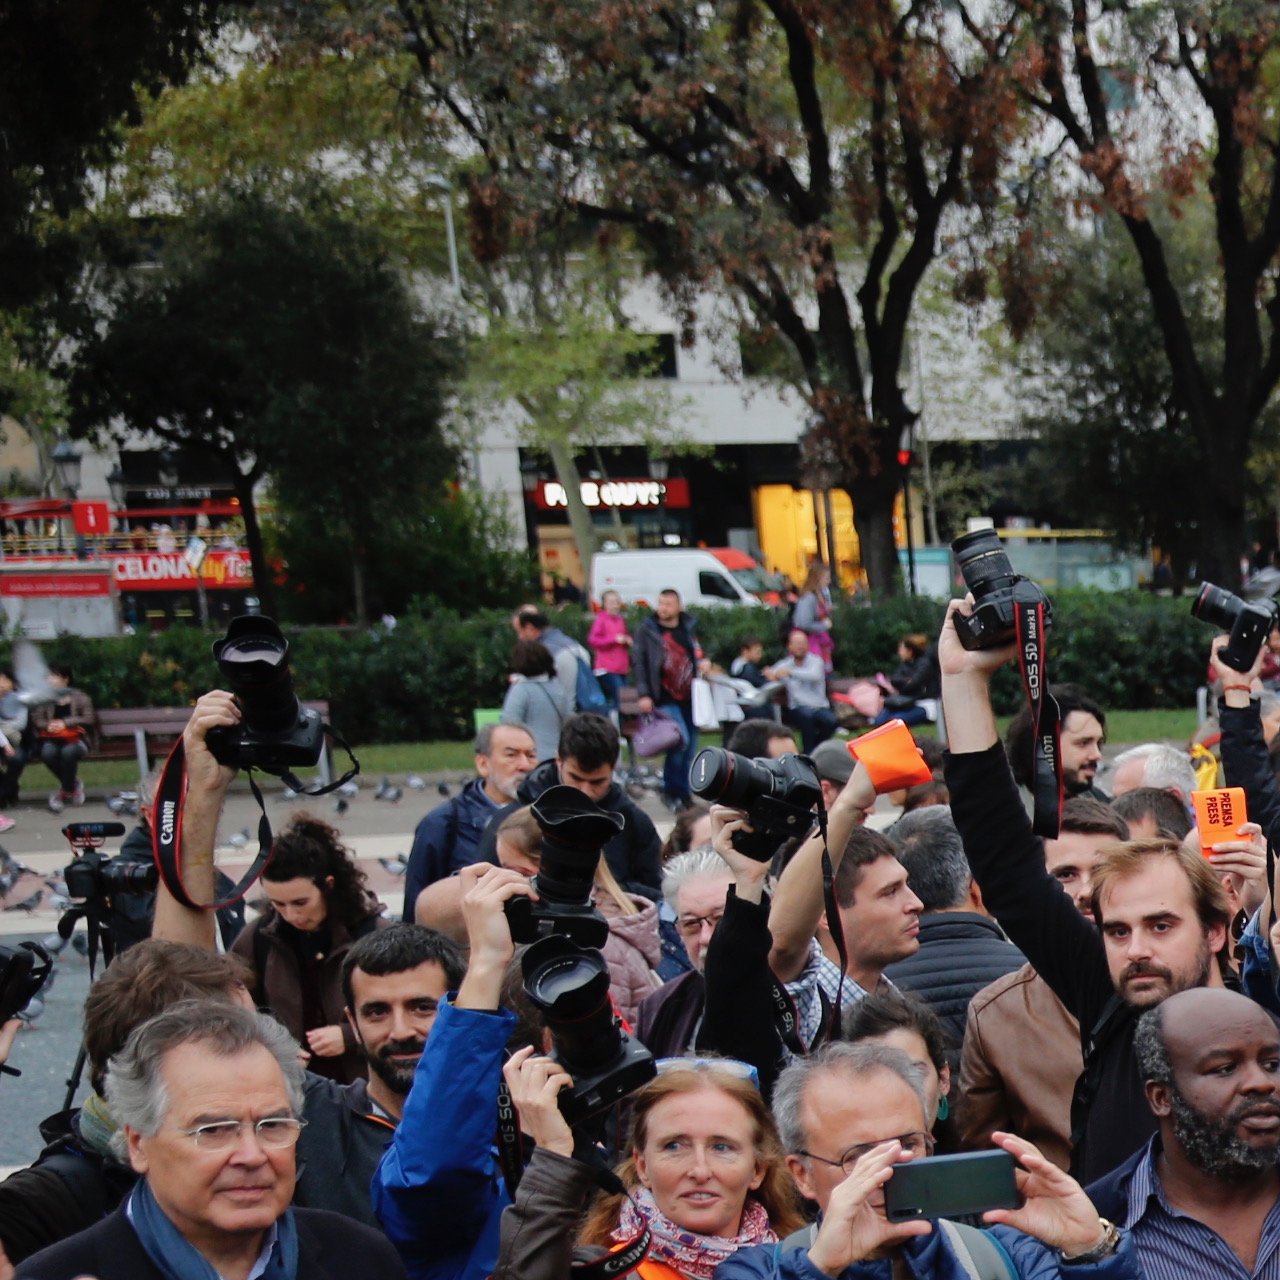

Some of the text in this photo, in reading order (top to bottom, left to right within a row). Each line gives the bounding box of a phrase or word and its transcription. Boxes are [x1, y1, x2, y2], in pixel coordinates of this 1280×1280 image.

[1025, 642, 1038, 661] 5D
[1027, 664, 1040, 700] EOS
[160, 800, 176, 845] Canon
[1205, 796, 1220, 825] PRESS
[1219, 792, 1233, 828] PREMSA
[604, 1230, 651, 1272] Canon
